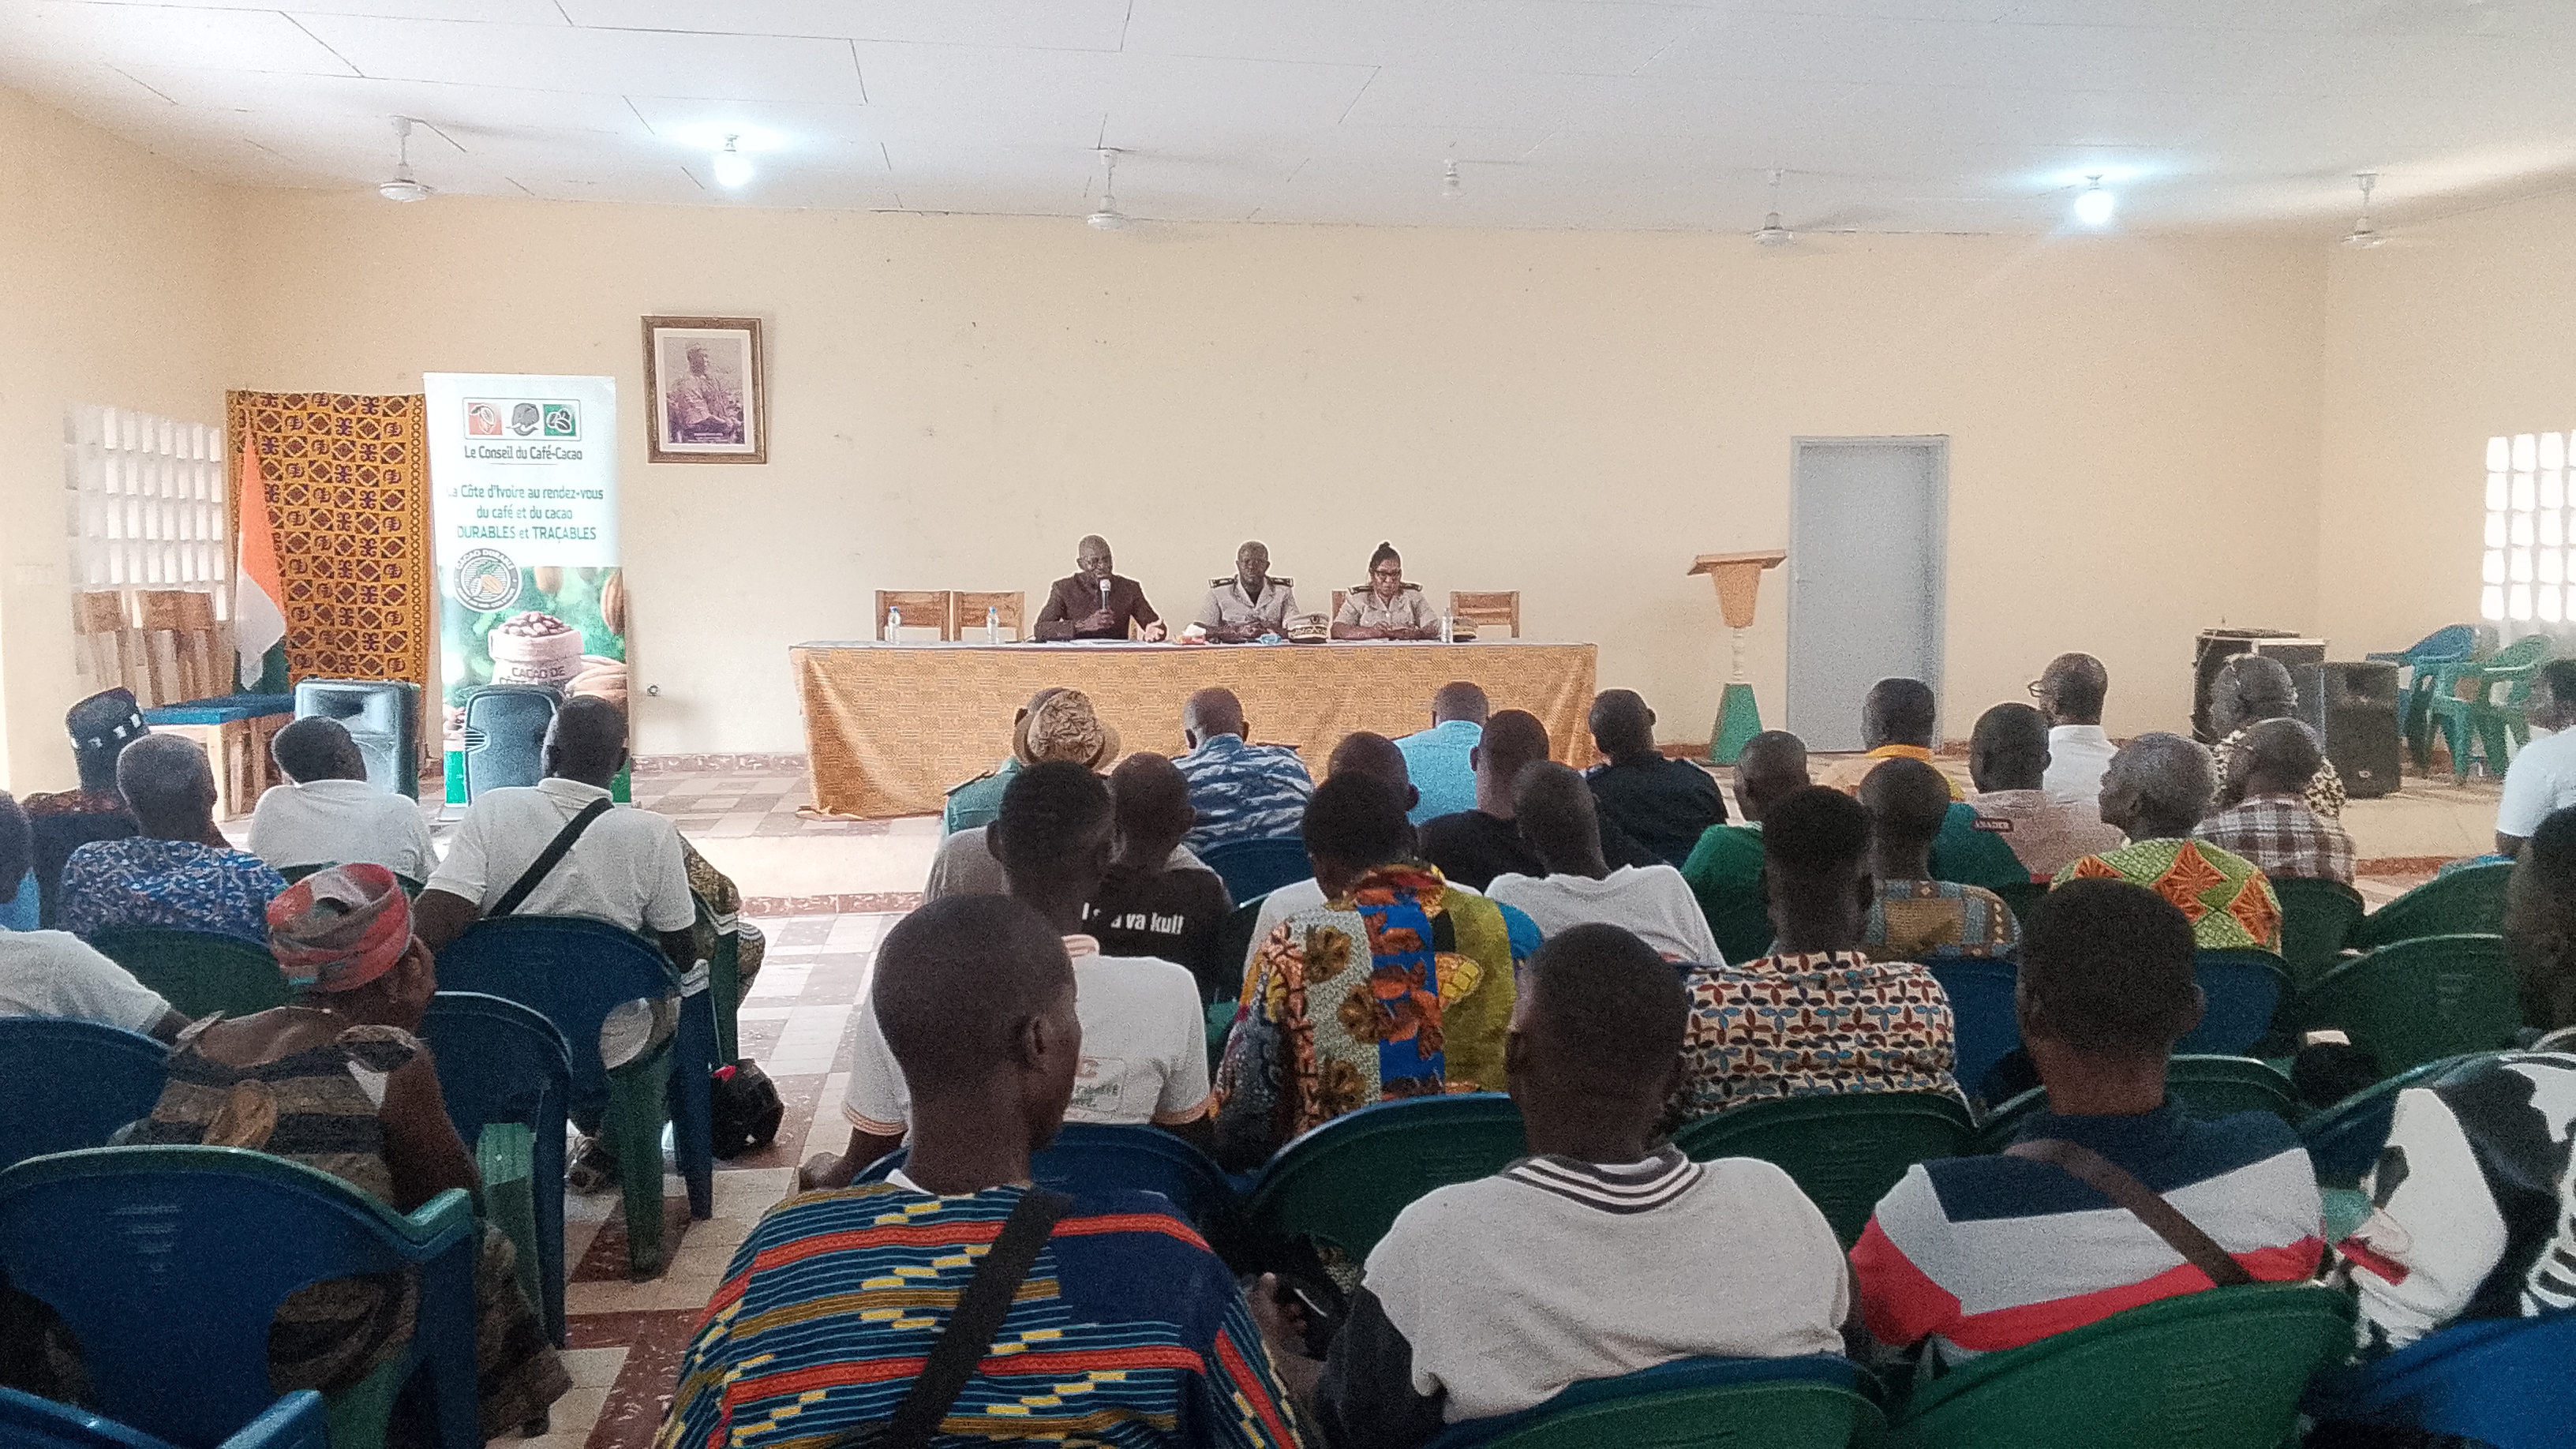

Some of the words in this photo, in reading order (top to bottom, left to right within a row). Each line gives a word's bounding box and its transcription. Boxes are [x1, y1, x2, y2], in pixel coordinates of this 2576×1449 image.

[464, 445, 477, 459] Le
[478, 445, 514, 459] Conseil
[515, 446, 527, 459] du
[530, 444, 583, 460] Café-Cacao
[447, 486, 458, 498] La
[461, 484, 485, 498] Côte
[488, 484, 525, 499] d'Ivoire
[528, 489, 540, 499] au
[543, 485, 604, 500] rendez-vous
[477, 505, 489, 519] du
[492, 504, 514, 519] café
[516, 507, 527, 519] et
[530, 505, 542, 519] du
[545, 509, 573, 519] cacao
[457, 526, 515, 539] DURABLES
[519, 528, 530, 539] et
[531, 526, 597, 544] TRAÇABLES
[456, 549, 481, 570] CACAO
[511, 667, 548, 679] CACAO
[550, 665, 566, 678] DE
[1125, 913, 1146, 930] va
